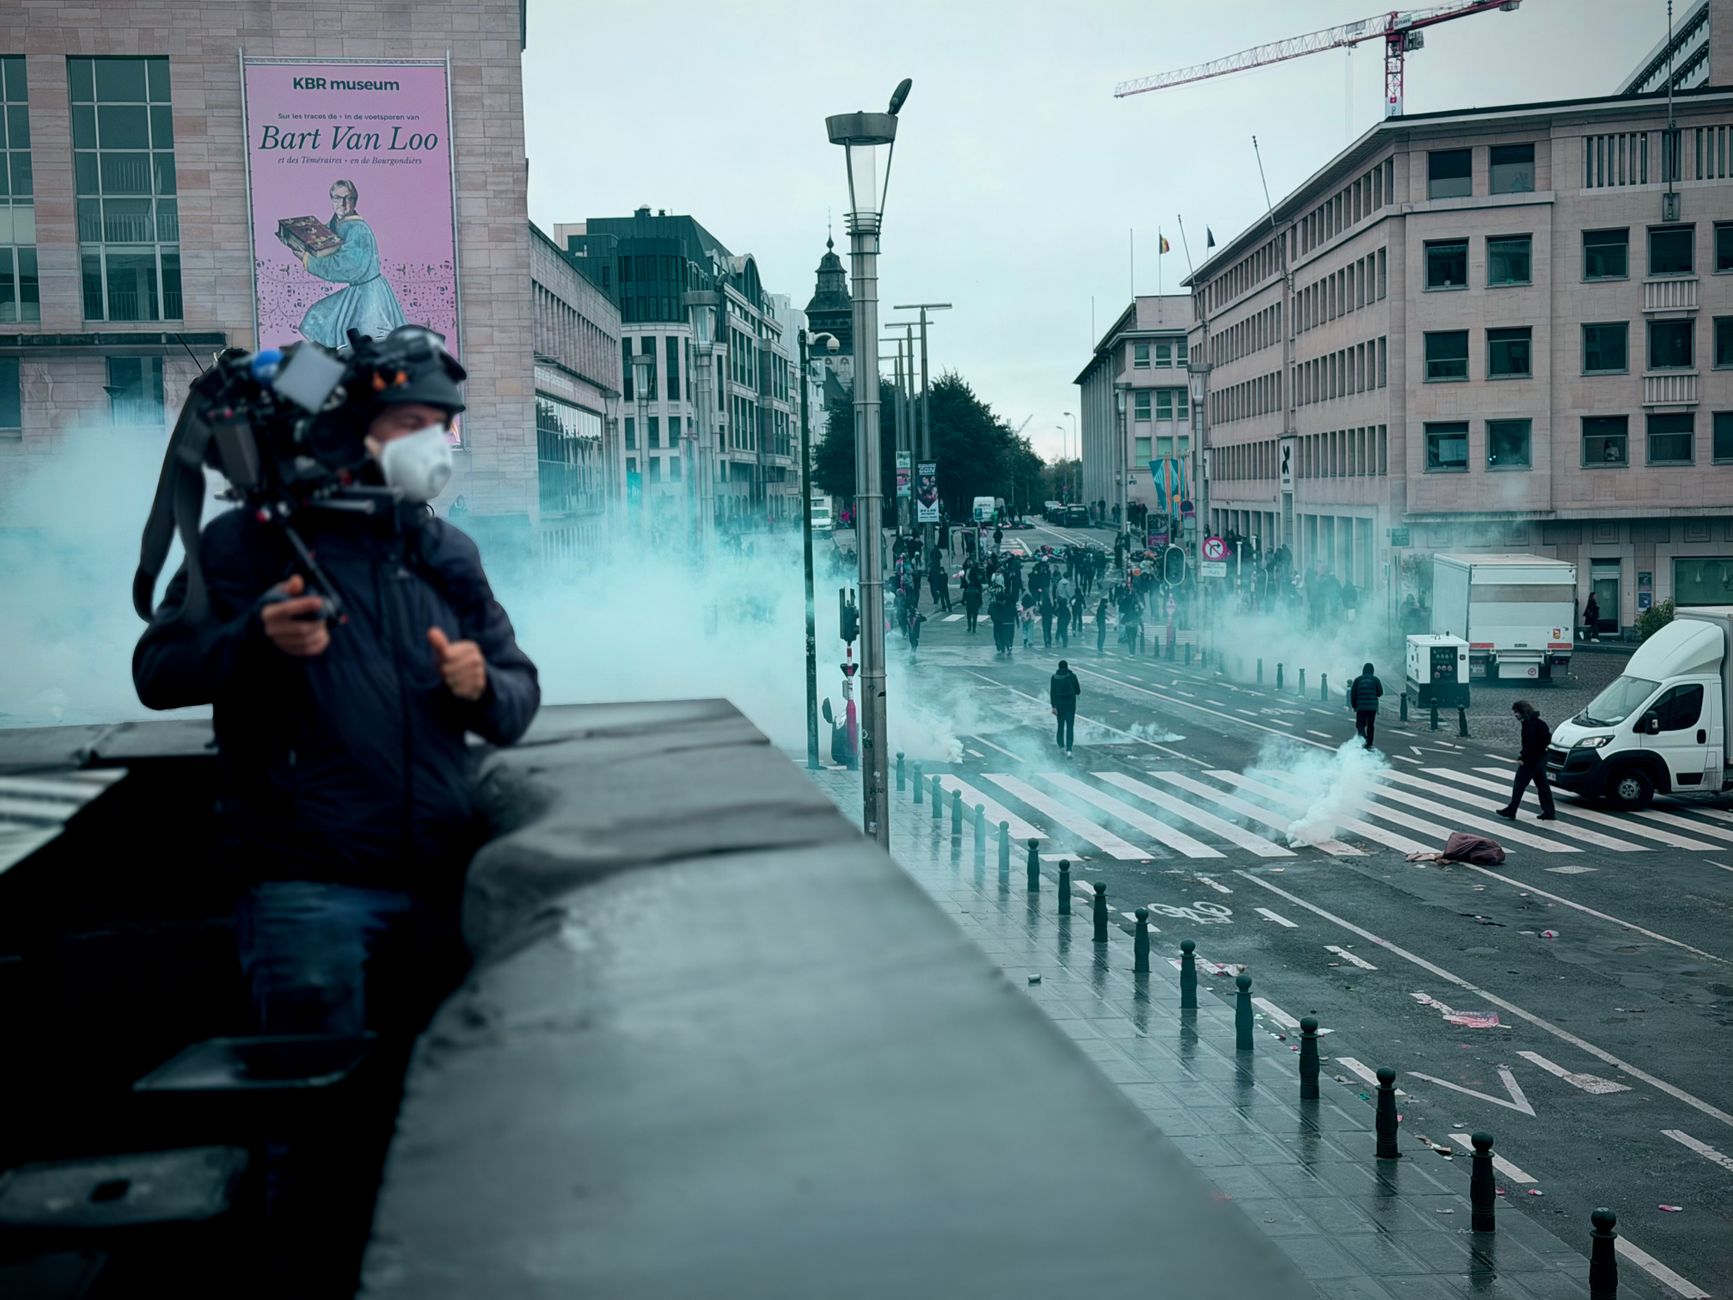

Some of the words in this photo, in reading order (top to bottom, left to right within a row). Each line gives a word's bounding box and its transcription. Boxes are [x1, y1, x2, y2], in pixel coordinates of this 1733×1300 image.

[293, 77, 327, 90] KBR
[330, 80, 400, 91] museum
[278, 112, 290, 120] Sur
[292, 112, 302, 120] les
[364, 113, 405, 121] voetsporen
[258, 125, 321, 150] Bart
[332, 125, 381, 150] Van
[388, 126, 439, 151] Loo
[286, 156, 299, 164] des
[361, 156, 371, 165] de
